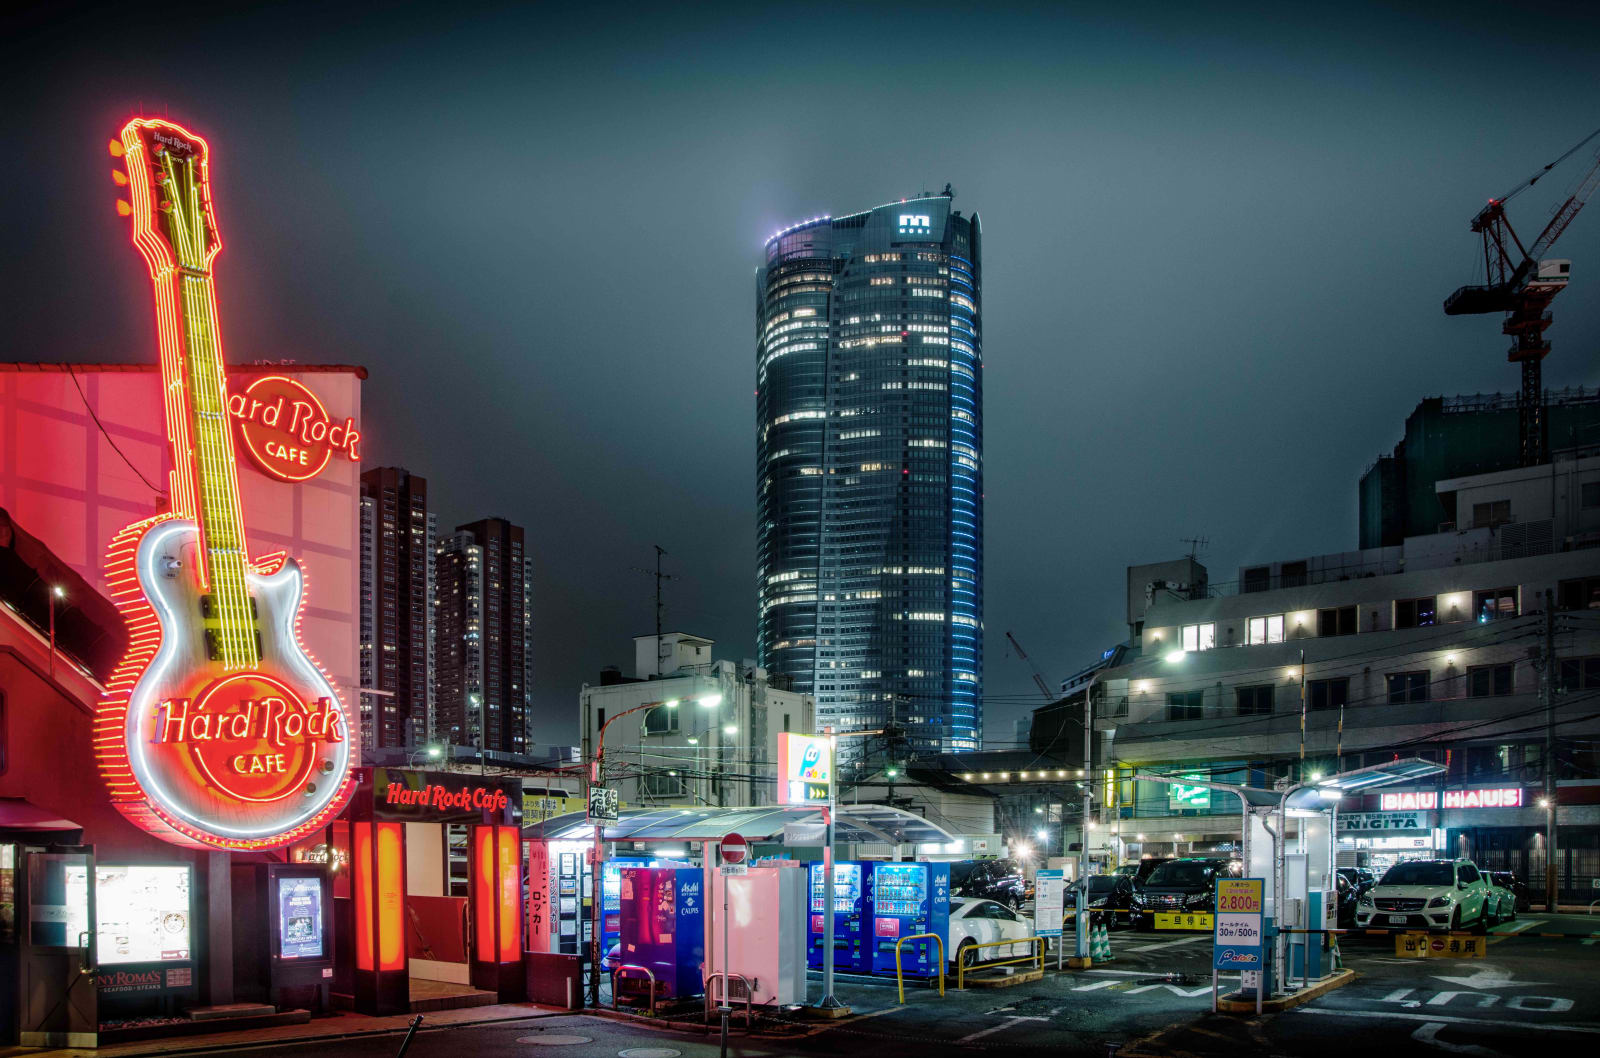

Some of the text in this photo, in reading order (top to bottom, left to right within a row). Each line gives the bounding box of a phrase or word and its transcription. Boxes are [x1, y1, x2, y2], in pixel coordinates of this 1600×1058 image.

[154, 132, 173, 145] Hard
[174, 138, 192, 153] Rock
[290, 401, 360, 460] Rock
[265, 441, 308, 466] CAFE
[162, 697, 343, 746] Hard Rock
[234, 753, 286, 774] CAFE
[386, 782, 508, 812] Hard Rock Cafe
[1384, 789, 1518, 810] BAU HAUS
[1346, 818, 1418, 830] NIGITA
[532, 891, 541, 936] ロッカー
[681, 907, 699, 916] CALPIS
[1161, 915, 1212, 926] 一旦停止
[1405, 939, 1476, 953] 出口 専用
